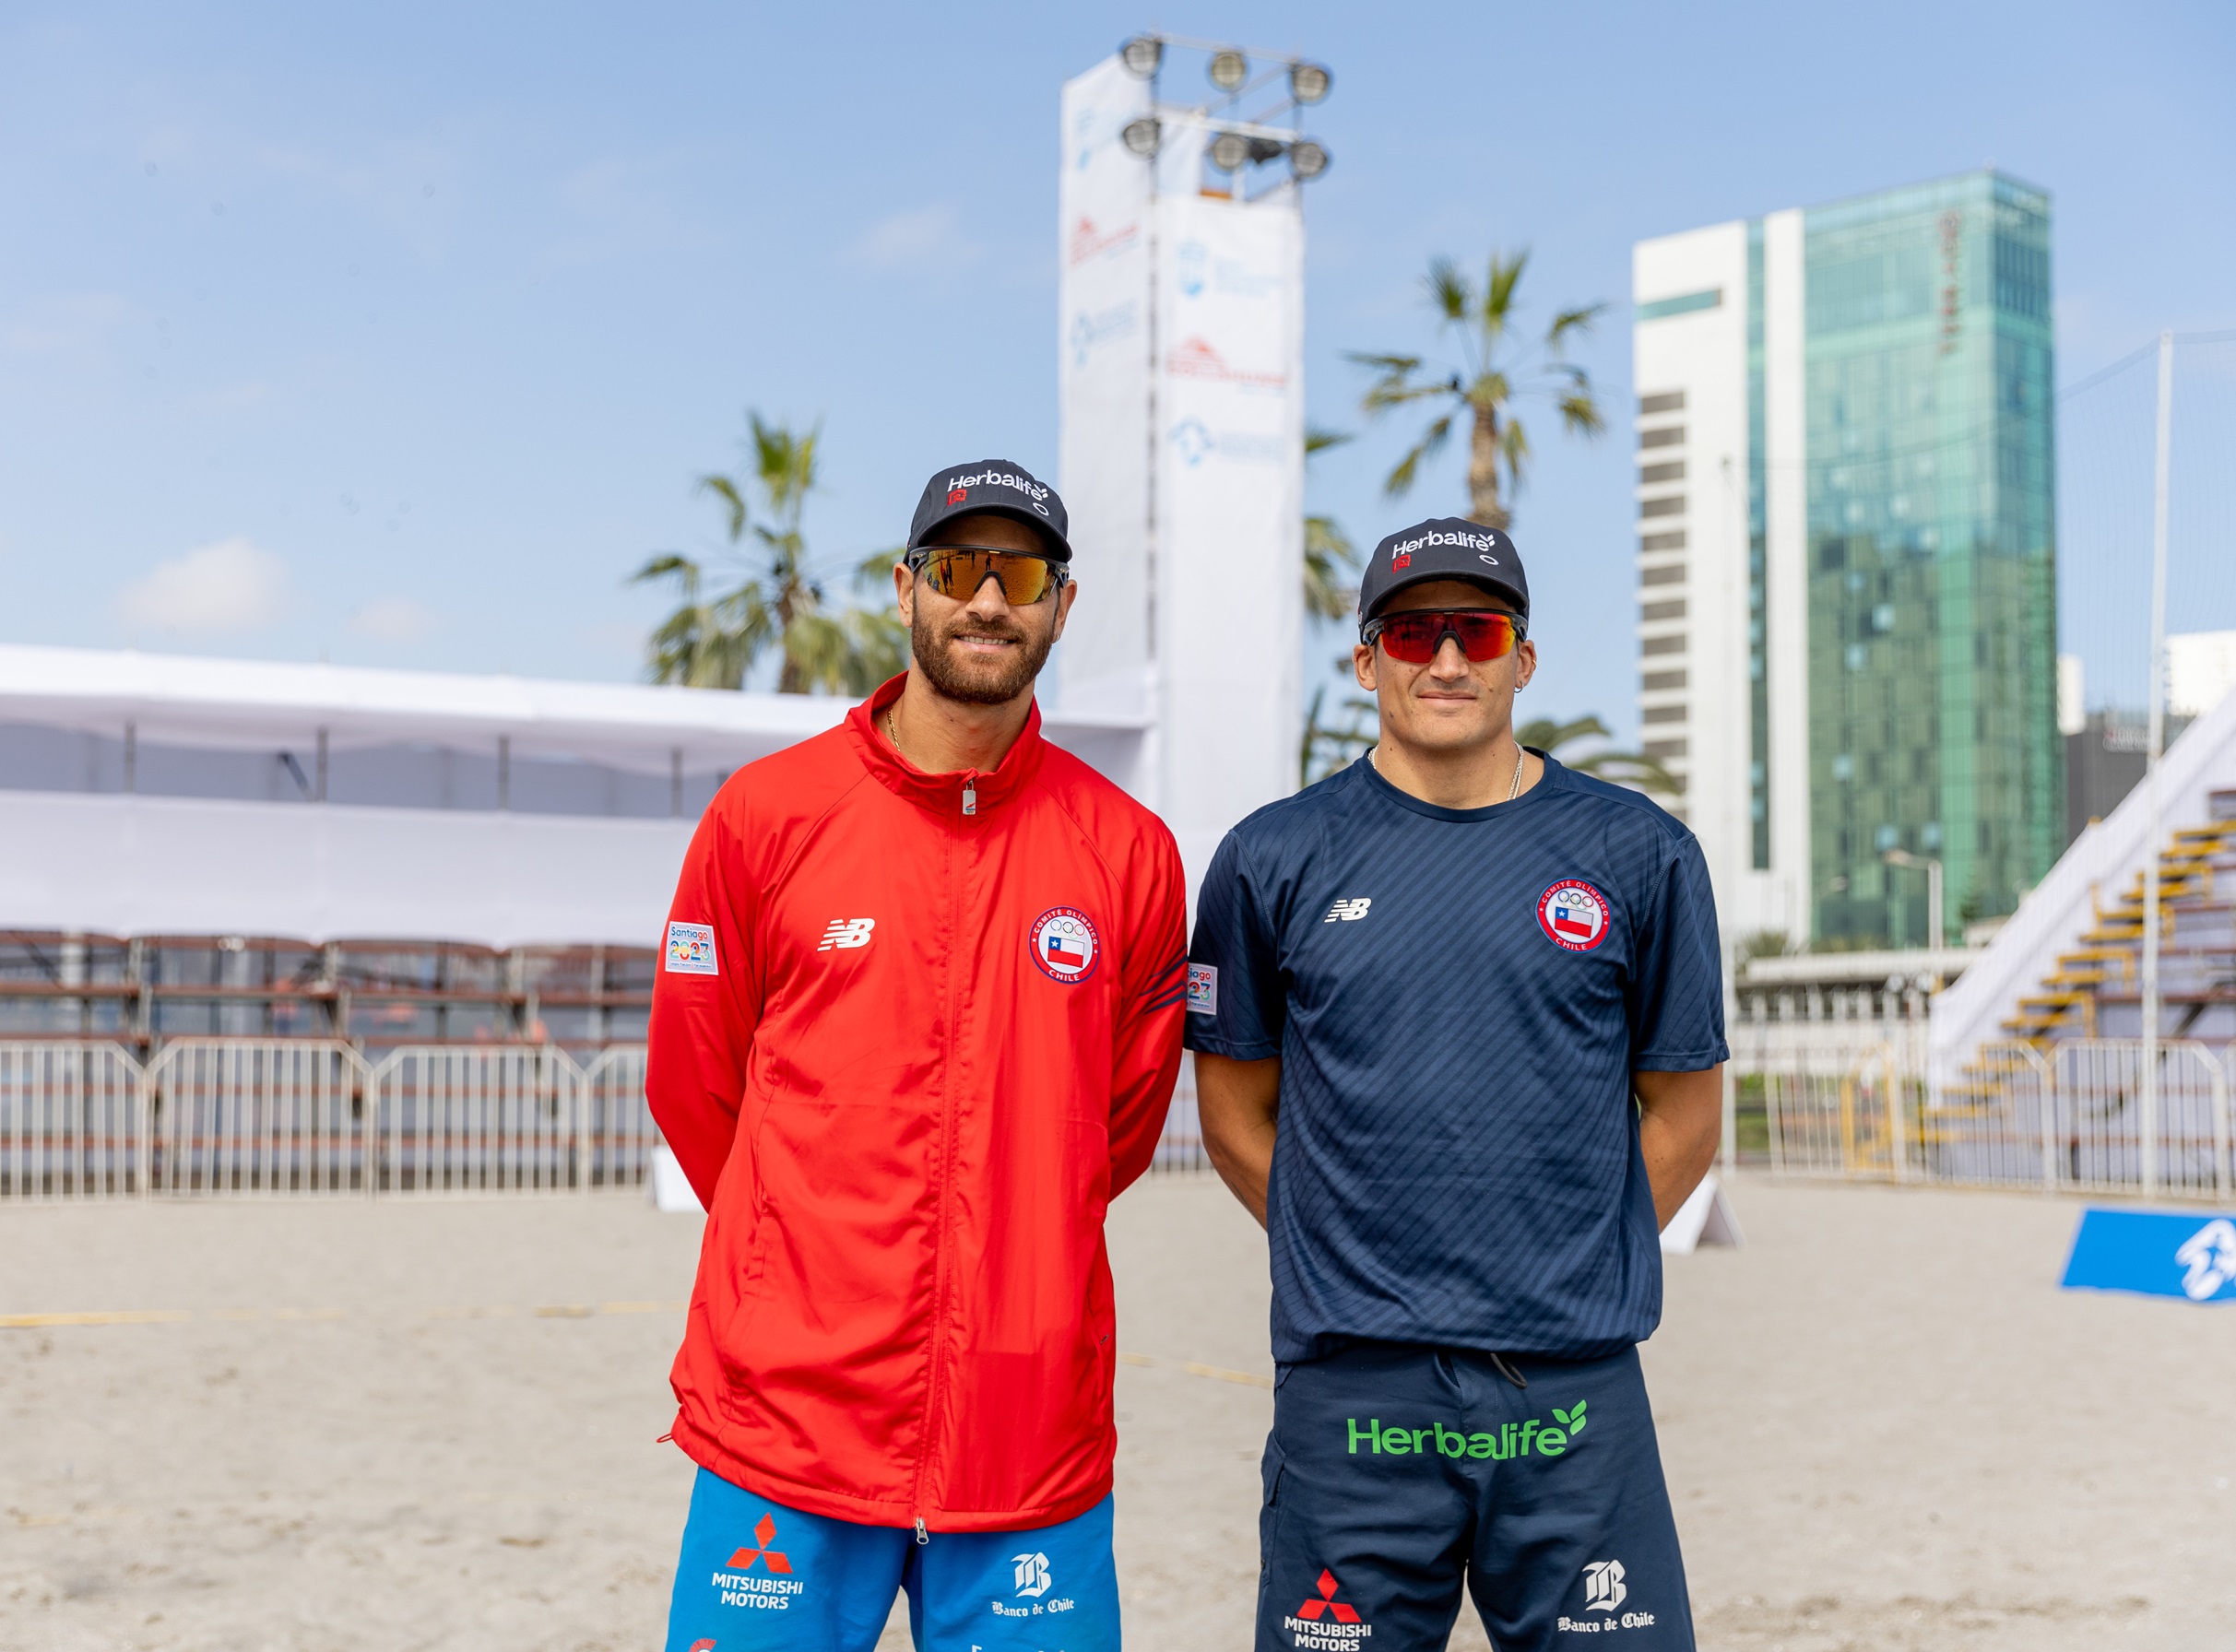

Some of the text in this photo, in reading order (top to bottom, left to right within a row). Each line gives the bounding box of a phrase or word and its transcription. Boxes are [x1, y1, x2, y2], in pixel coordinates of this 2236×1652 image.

[947, 469, 1044, 502] Herbalife
[1391, 530, 1490, 560] Herbalife
[1034, 908, 1063, 934] COMITÉ
[671, 926, 708, 941] Santiago
[670, 940, 711, 961] 2023
[1556, 938, 1588, 951] CHILE
[1048, 969, 1080, 982] CHILE
[1347, 1419, 1568, 1460] Herbalife
[712, 1572, 804, 1595] MITSUBISHI
[721, 1590, 789, 1610] MOTORS
[991, 1598, 1075, 1618] Banco de Chile
[1284, 1615, 1372, 1637] MITSUBISHI
[1557, 1611, 1656, 1633] Banco de Chile
[1295, 1633, 1361, 1652] MOTORS
